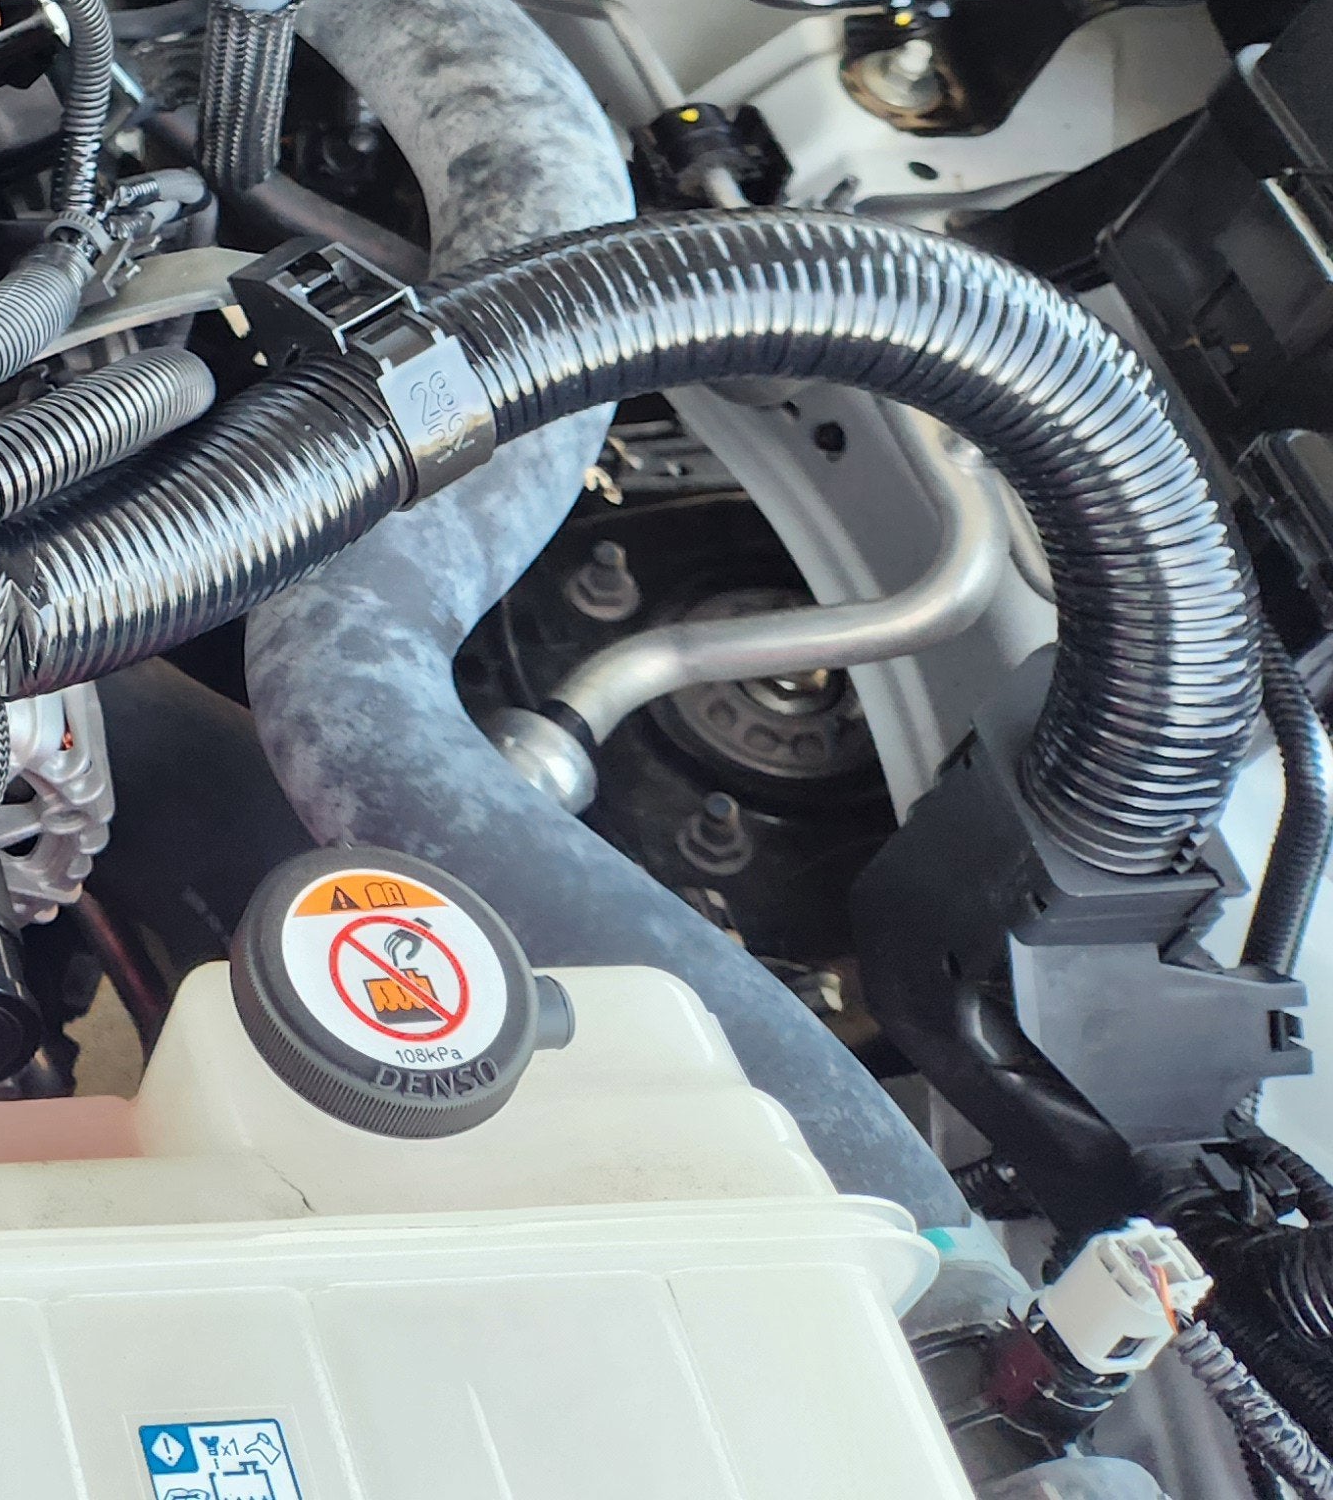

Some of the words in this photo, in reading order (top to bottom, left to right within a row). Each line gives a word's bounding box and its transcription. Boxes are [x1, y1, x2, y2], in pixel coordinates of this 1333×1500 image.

[409, 369, 459, 427] 28
[373, 1055, 500, 1101] DENSO
[395, 1045, 464, 1065] 108kPa
